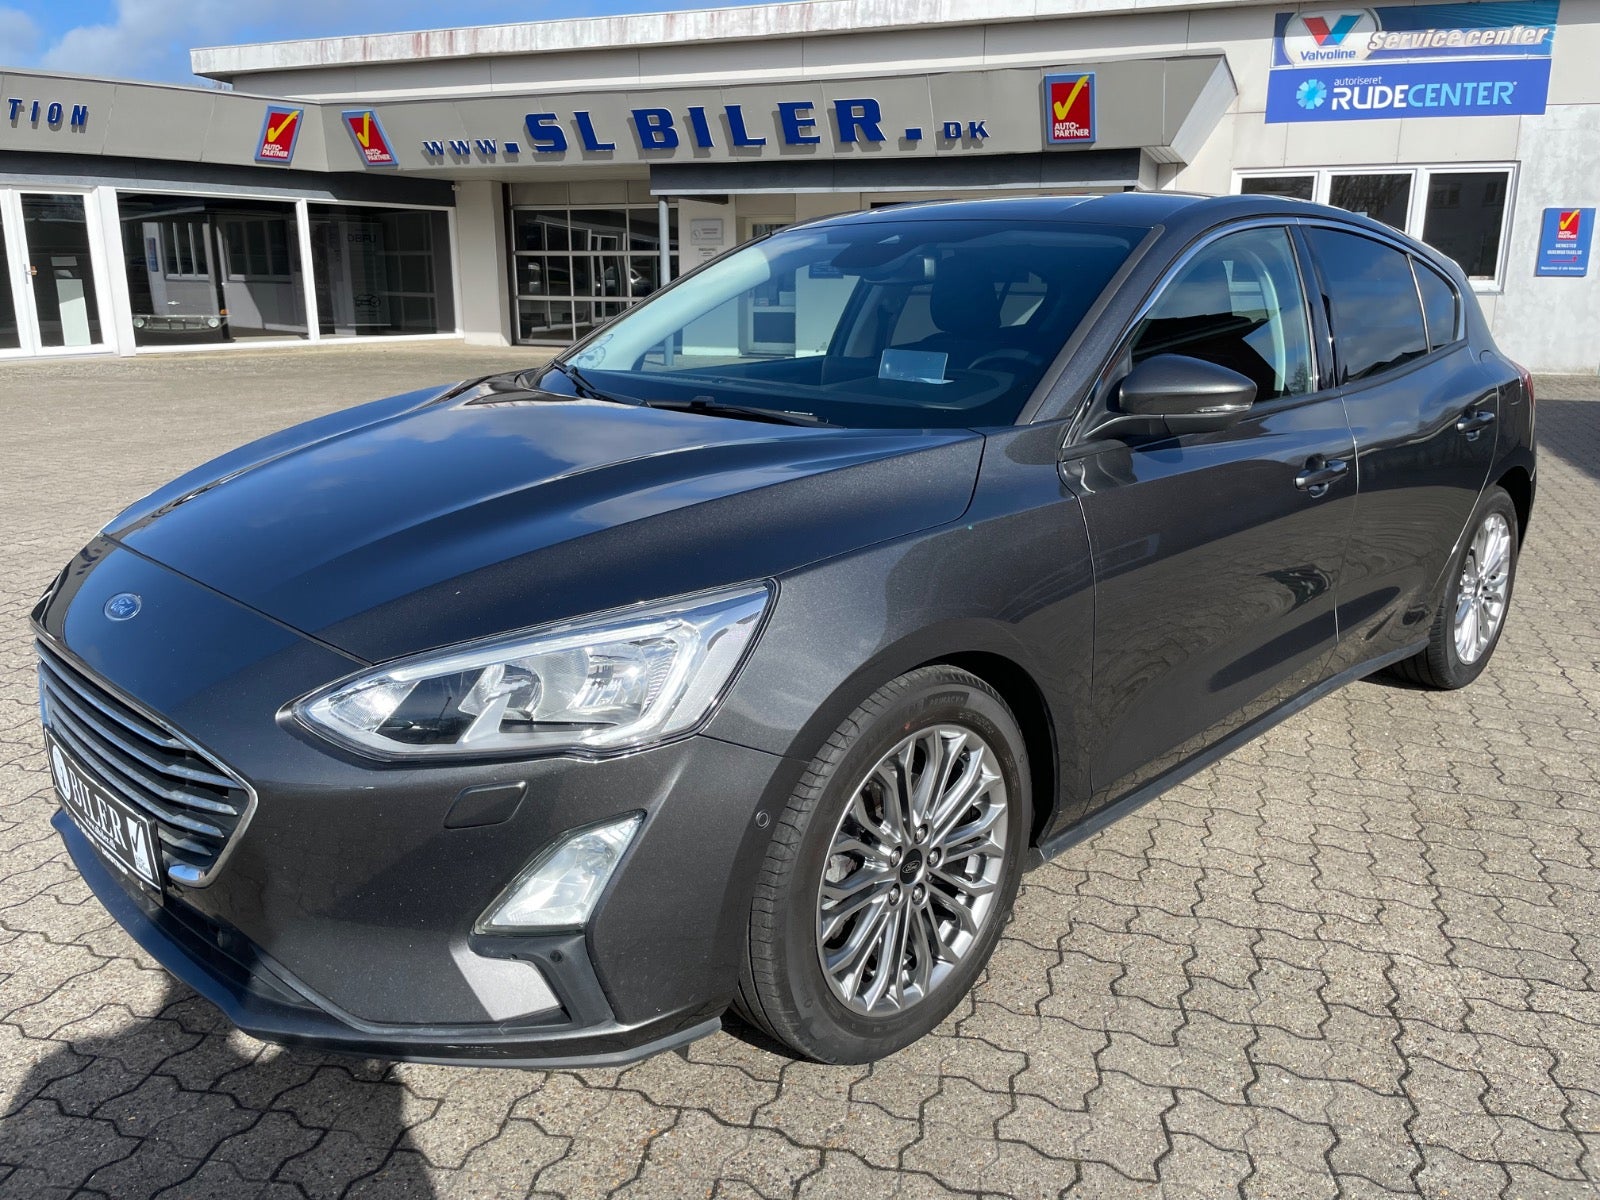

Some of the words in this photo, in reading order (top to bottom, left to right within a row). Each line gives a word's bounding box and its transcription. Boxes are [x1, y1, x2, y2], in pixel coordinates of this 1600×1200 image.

[1368, 30, 1463, 52] Service
[1464, 25, 1550, 48] center
[1300, 49, 1357, 62] Valvoline
[1334, 76, 1383, 87] autoriseret
[1331, 81, 1515, 111] RUDECENTER
[7, 97, 88, 126] TION
[1054, 122, 1079, 130] AUTO-
[1054, 129, 1090, 138] PARTNER
[261, 149, 289, 158] PARTNER
[68, 766, 129, 851] BILER
